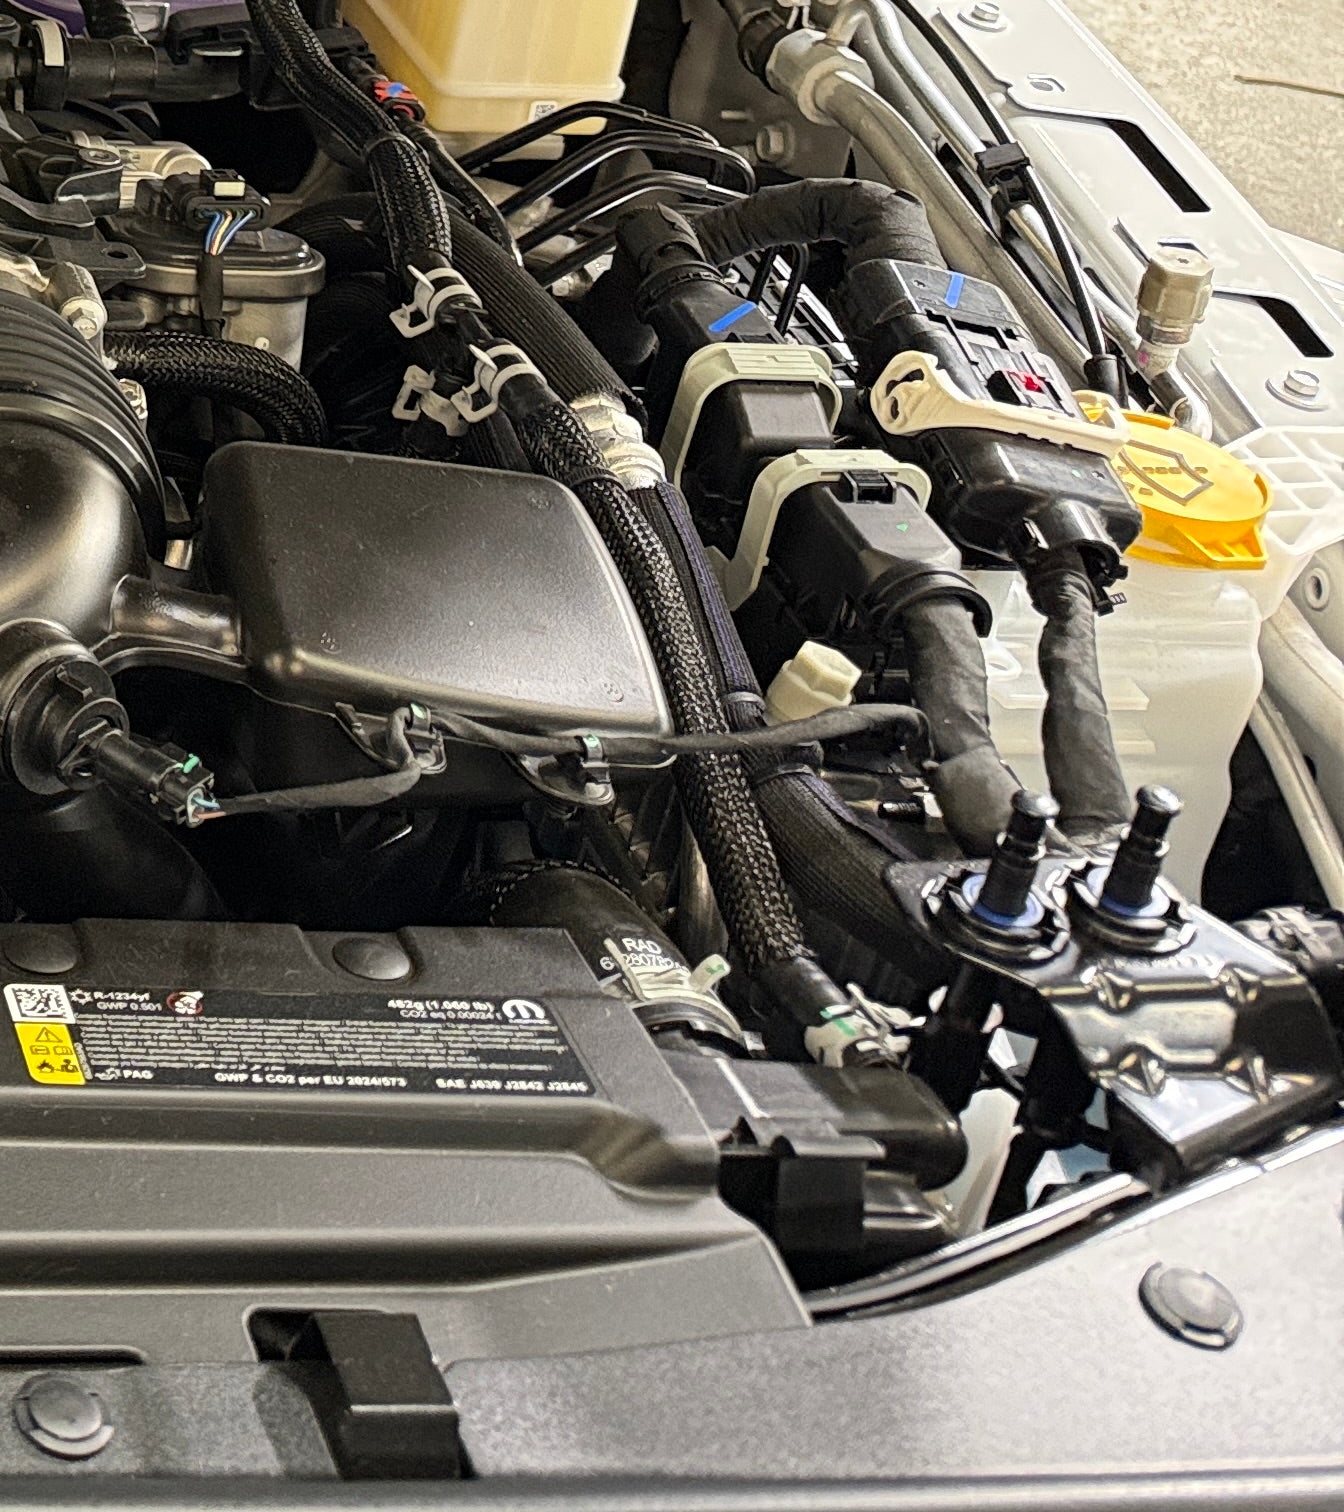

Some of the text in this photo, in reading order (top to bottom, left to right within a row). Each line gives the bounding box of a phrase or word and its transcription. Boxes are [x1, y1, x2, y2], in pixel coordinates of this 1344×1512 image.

[621, 937, 663, 955] RAD
[123, 1069, 154, 1080] PAG
[214, 1072, 249, 1083] GWP
[265, 1073, 296, 1085] CO2
[297, 1075, 321, 1086] per
[322, 1075, 344, 1086] EU
